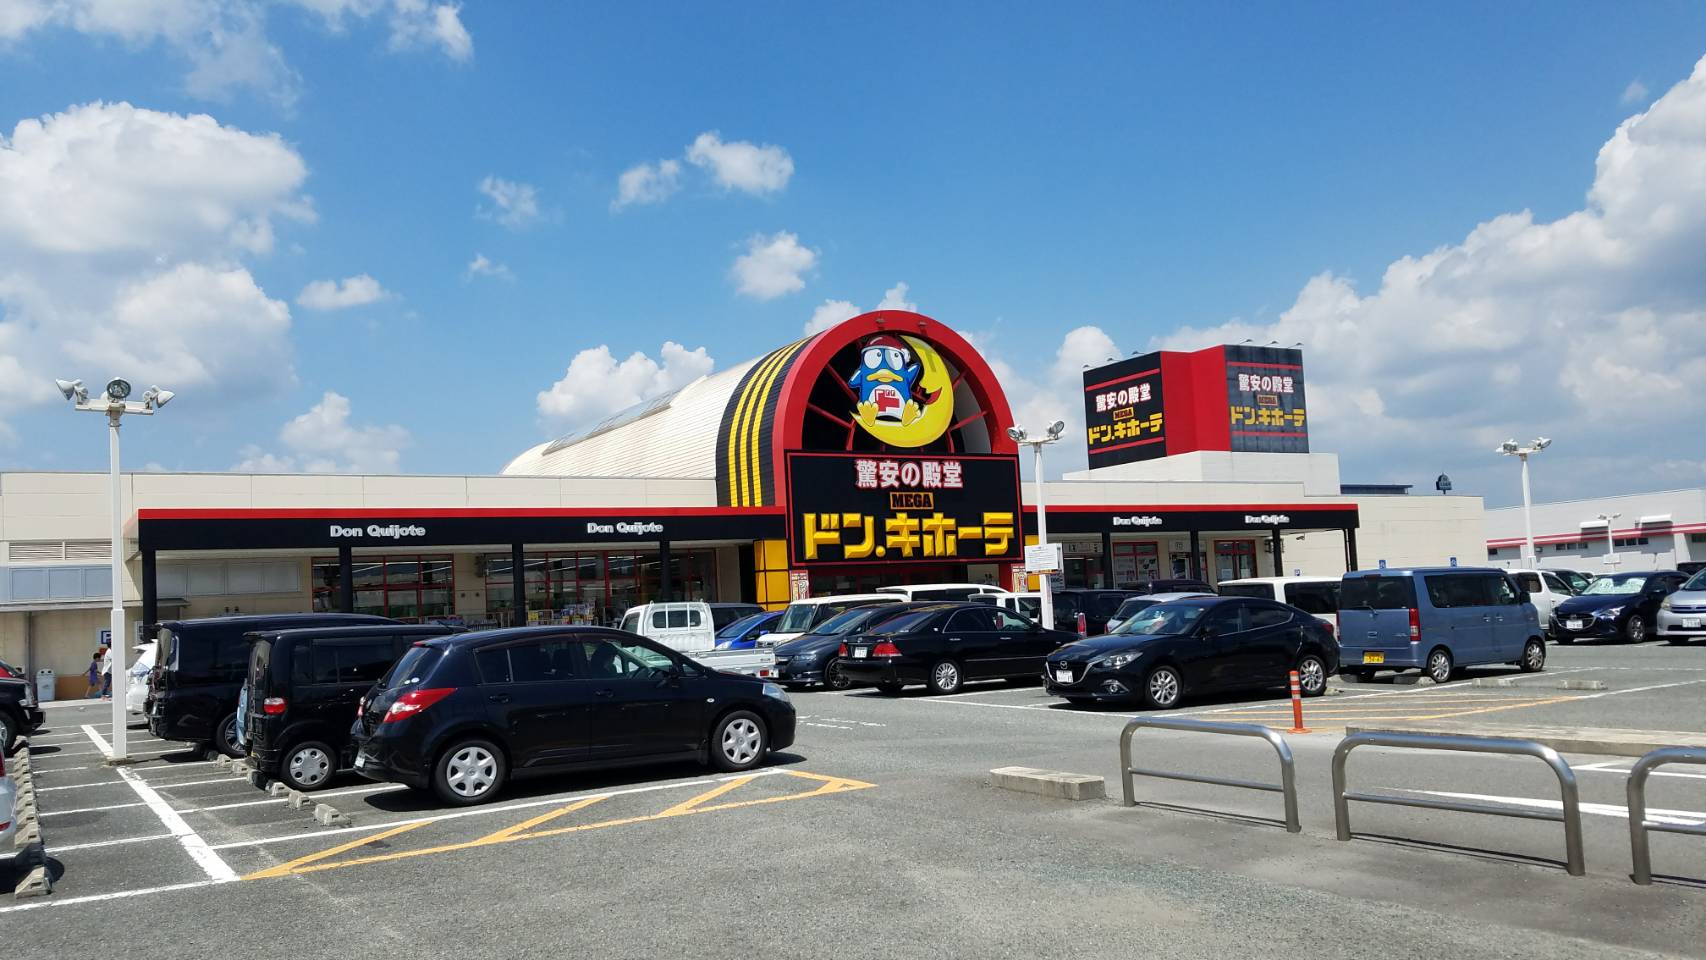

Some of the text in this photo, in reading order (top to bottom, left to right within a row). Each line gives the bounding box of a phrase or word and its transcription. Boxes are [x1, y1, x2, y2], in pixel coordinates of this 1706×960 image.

[855, 459, 963, 488] 驚安の殿堂
[891, 494, 933, 508] MEGA
[330, 524, 426, 539] Don Quijote
[586, 521, 664, 536] Don Quijote
